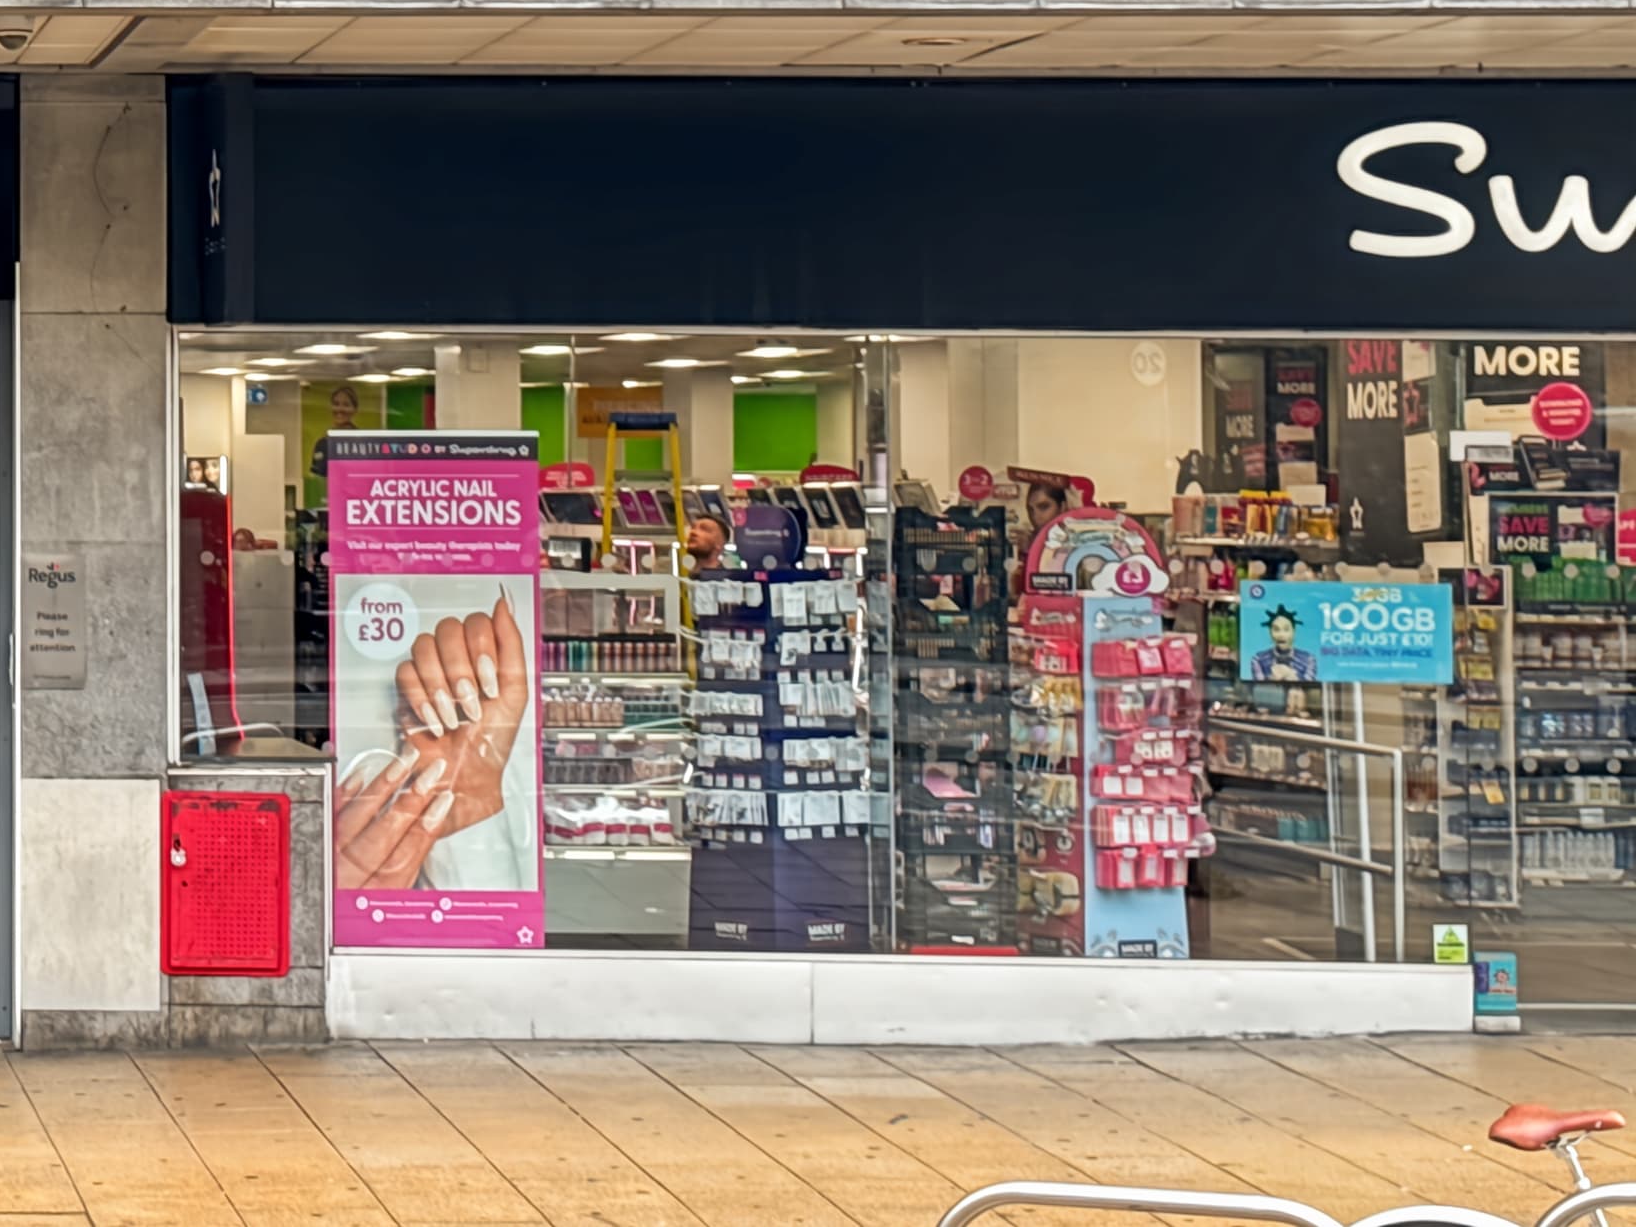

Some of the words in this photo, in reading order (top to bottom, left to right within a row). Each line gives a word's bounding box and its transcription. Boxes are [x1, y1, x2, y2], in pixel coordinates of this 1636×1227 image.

[1347, 340, 1397, 373] SAVE
[1474, 345, 1581, 376] MORE
[1347, 381, 1397, 420] MORE
[370, 480, 450, 498] ACRYLIC
[454, 480, 497, 498] NAIL
[346, 500, 522, 525] EXTENSIONS
[1499, 517, 1549, 533] SAVE
[1497, 536, 1549, 552] MORE
[28, 567, 76, 589] Regus
[360, 597, 403, 615] from
[37, 611, 68, 621] Please
[1319, 603, 1436, 631] 100GB
[35, 628, 54, 638] ring
[56, 628, 70, 636] for
[358, 618, 405, 642] £30
[1321, 631, 1355, 646] FOR
[1358, 632, 1398, 646] JUST
[30, 643, 76, 652] attention
